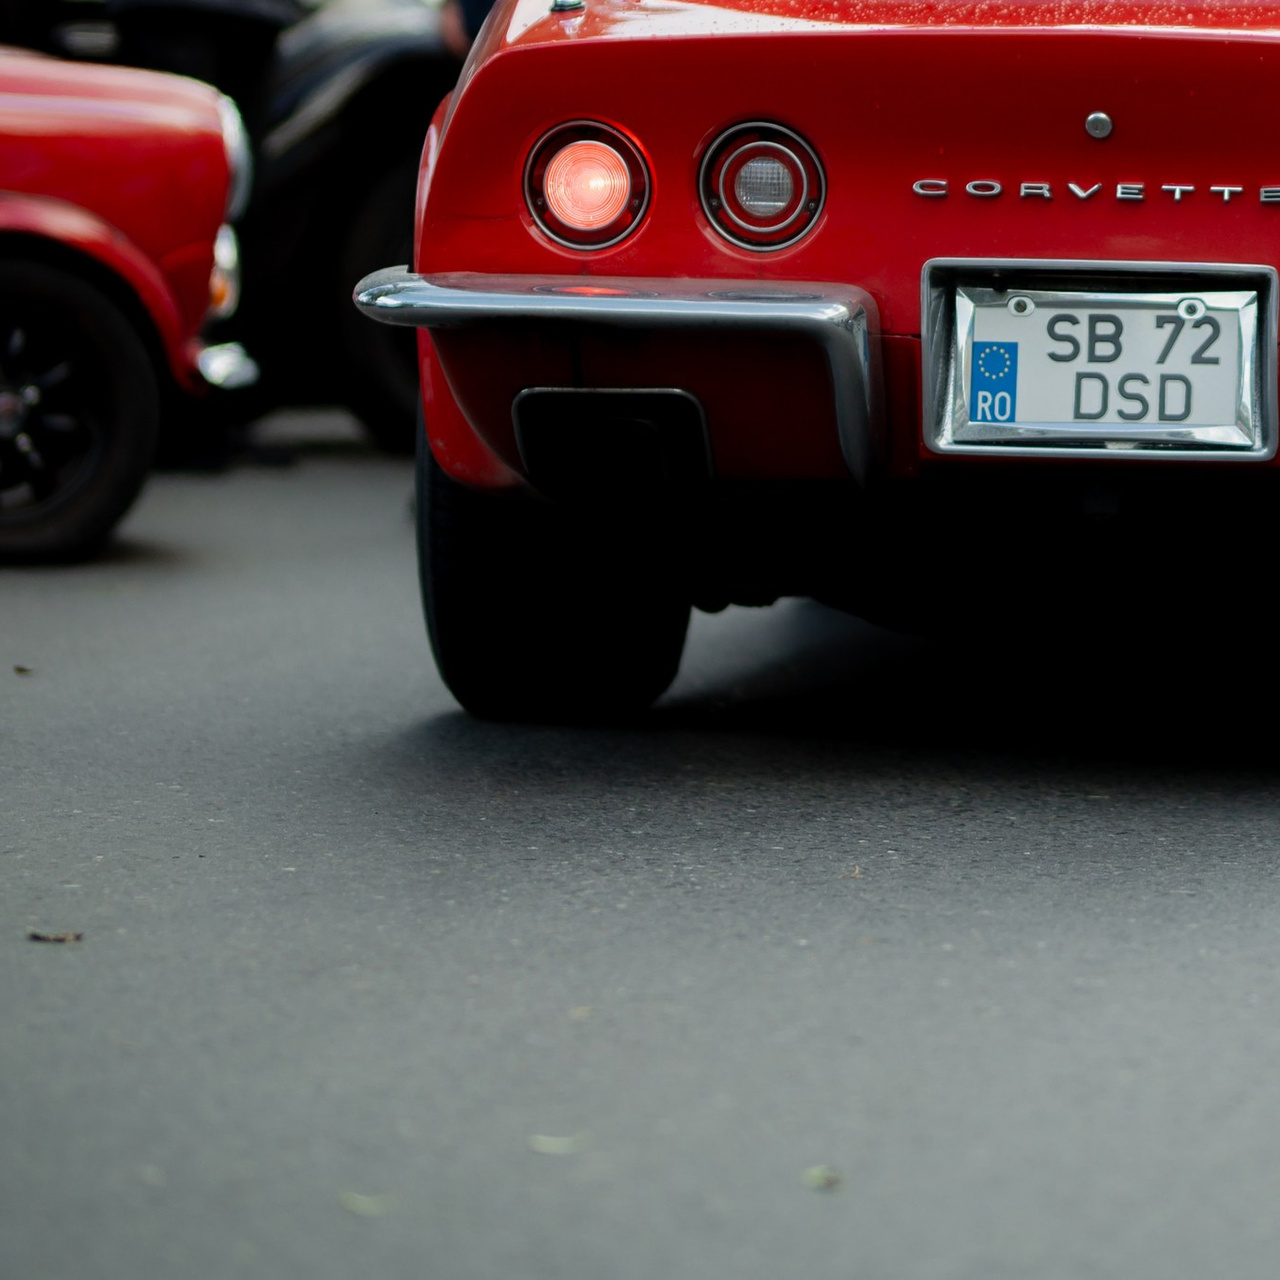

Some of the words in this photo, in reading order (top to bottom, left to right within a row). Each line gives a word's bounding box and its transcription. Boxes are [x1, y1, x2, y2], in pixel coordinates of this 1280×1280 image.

[1046, 313, 1123, 364] SB
[1155, 314, 1221, 365] 72
[976, 391, 1012, 421] RO
[1073, 371, 1192, 421] DSD
